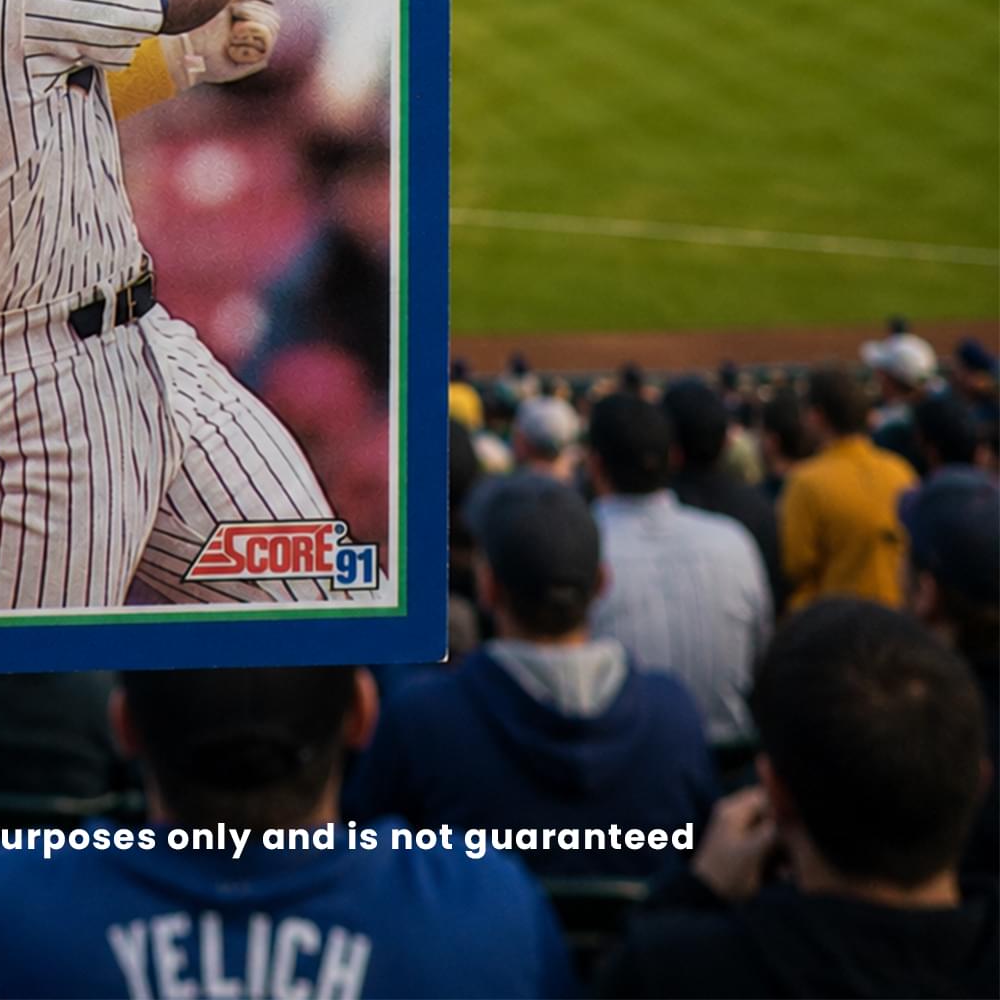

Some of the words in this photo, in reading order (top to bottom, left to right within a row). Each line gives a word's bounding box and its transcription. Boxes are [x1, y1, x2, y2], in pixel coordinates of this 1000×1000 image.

[190, 522, 334, 577] SCORE
[335, 547, 374, 585] 91
[107, 910, 372, 1000] YELICH
